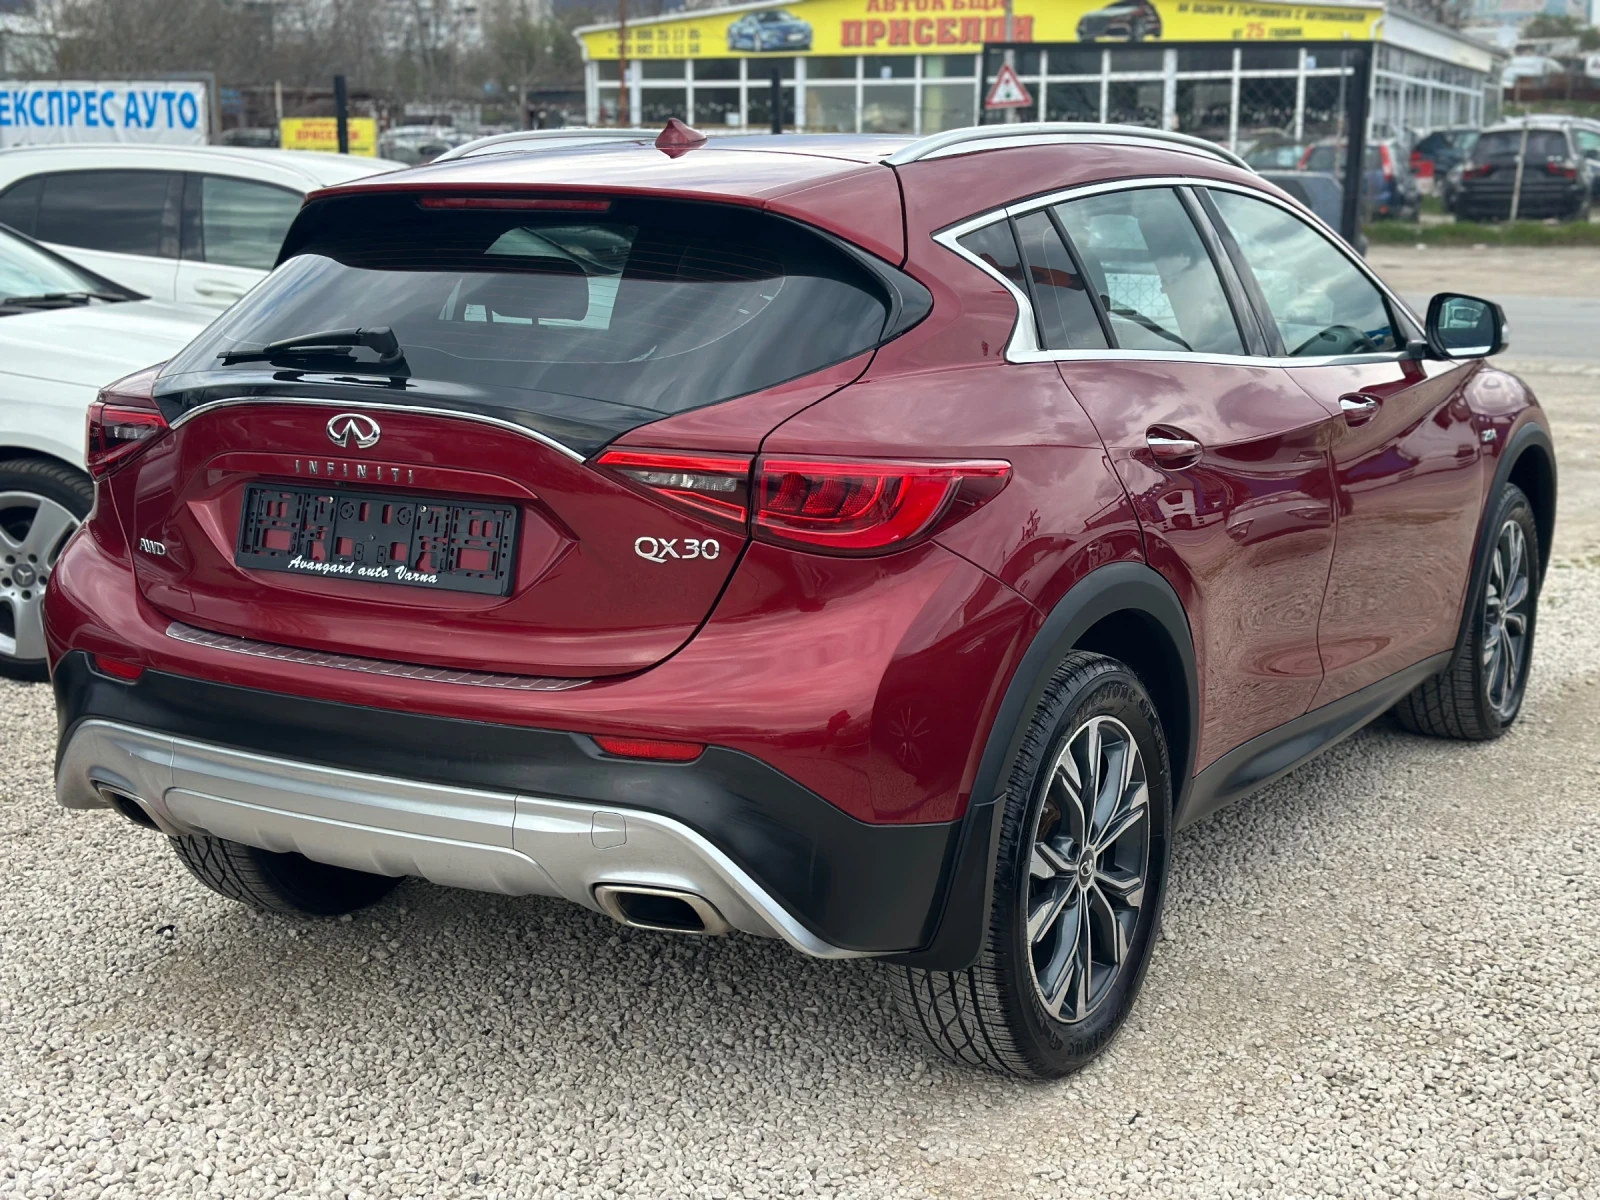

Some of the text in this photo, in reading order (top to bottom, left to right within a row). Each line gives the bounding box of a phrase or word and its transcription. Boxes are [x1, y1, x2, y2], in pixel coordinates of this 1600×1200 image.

[0, 91, 198, 129] ЕКСПРЕС АУТО
[295, 459, 414, 484] INFINITI
[139, 537, 166, 555] AWD
[634, 536, 720, 564] QX30
[287, 555, 438, 583] Avangard auto Varna
